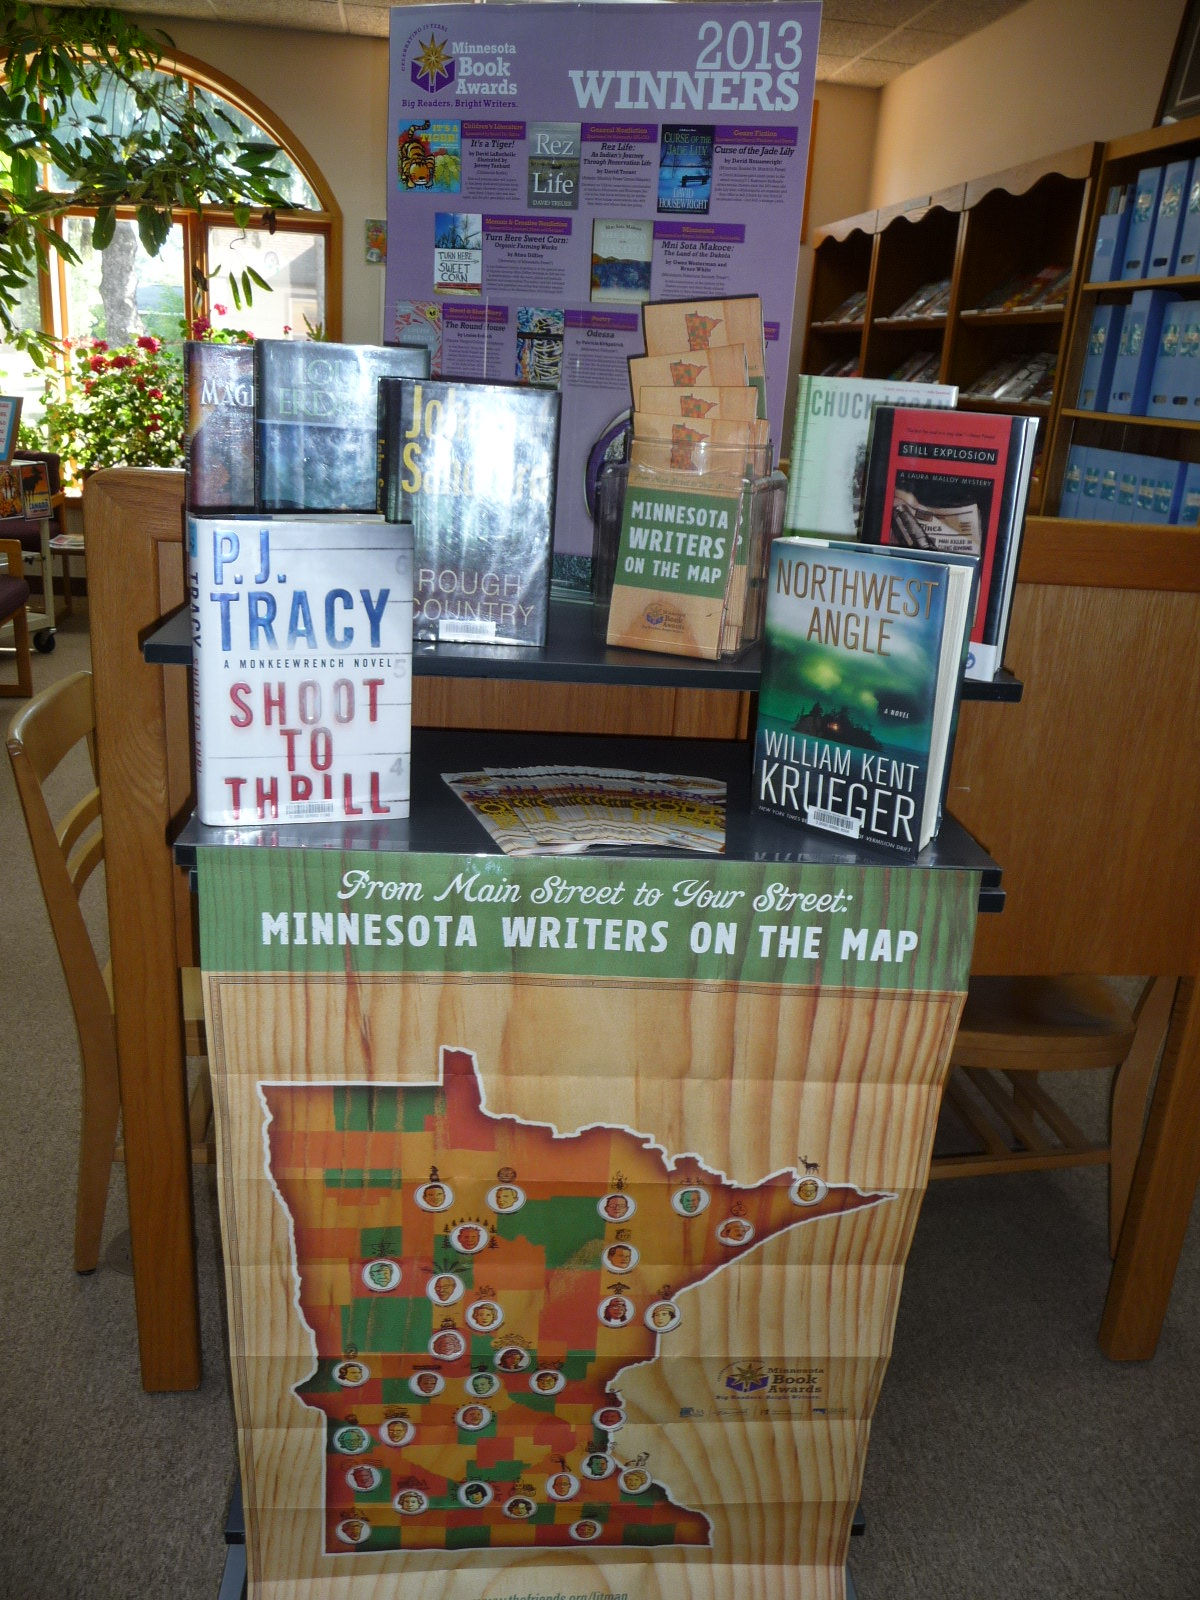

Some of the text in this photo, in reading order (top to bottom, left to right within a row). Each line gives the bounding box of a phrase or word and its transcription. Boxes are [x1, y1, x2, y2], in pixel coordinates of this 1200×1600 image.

[451, 42, 517, 54] Minnesota
[695, 20, 803, 71] 2013
[458, 56, 511, 77] Book
[455, 78, 518, 95] Awards
[568, 69, 800, 112] WINNERS
[401, 99, 519, 109] Big Readers. Bright Writers.
[664, 132, 690, 143] CURSE
[733, 129, 754, 137] Genre
[470, 139, 483, 148] It's
[491, 139, 516, 149] Tiger!
[535, 133, 574, 155] Rez
[600, 142, 636, 151] Rez Life:
[714, 146, 795, 157] Curse of the Jade Lily
[583, 158, 606, 166] Through
[532, 172, 574, 195] Life
[673, 187, 694, 199] DAVID
[658, 198, 709, 210] HOUSEWRIGHT
[485, 232, 569, 244] Turn Here Sweet Corn:
[494, 242, 516, 250] Organic
[517, 243, 541, 251] Farming
[661, 240, 735, 252] Mni Sota Makoce:
[438, 251, 473, 260] TURN HERE
[438, 263, 471, 274] SWEET
[440, 272, 468, 282] CORN
[445, 321, 460, 329] The
[459, 322, 483, 331] Round
[586, 329, 615, 339] Odessa
[810, 388, 878, 420] CHUCK
[902, 443, 996, 463] STILL EXPLOSION
[900, 471, 992, 488] A LAURA MALLOY MYSTERY
[631, 500, 729, 530] MINNESOTA
[629, 526, 726, 560] WRITERS
[212, 528, 288, 586] P.J.
[624, 556, 722, 585] ON THE MAP
[418, 568, 521, 596] ROUGH
[776, 558, 940, 620] NORTHWEST
[209, 588, 391, 652] TRACY
[412, 597, 535, 626] COUNTRY
[806, 606, 894, 657] ANGLE
[223, 658, 393, 669] A MONKEEWRENCH NOVEL
[229, 677, 385, 728] SHOOT
[890, 709, 910, 720] NOVEL
[279, 726, 334, 772] TO
[389, 756, 404, 777] 4
[764, 728, 920, 793] WILLIAM KENT
[224, 771, 391, 820] THRILL
[759, 759, 916, 843] KRUEGER
[758, 804, 771, 814] NEW
[771, 808, 786, 818] YORK
[337, 869, 854, 914] From Main Street to Your Street:
[261, 911, 919, 963] MINNESOTA WRITERS ON THE MAP
[772, 1374, 818, 1385] Book
[767, 1385, 822, 1393] Awards
